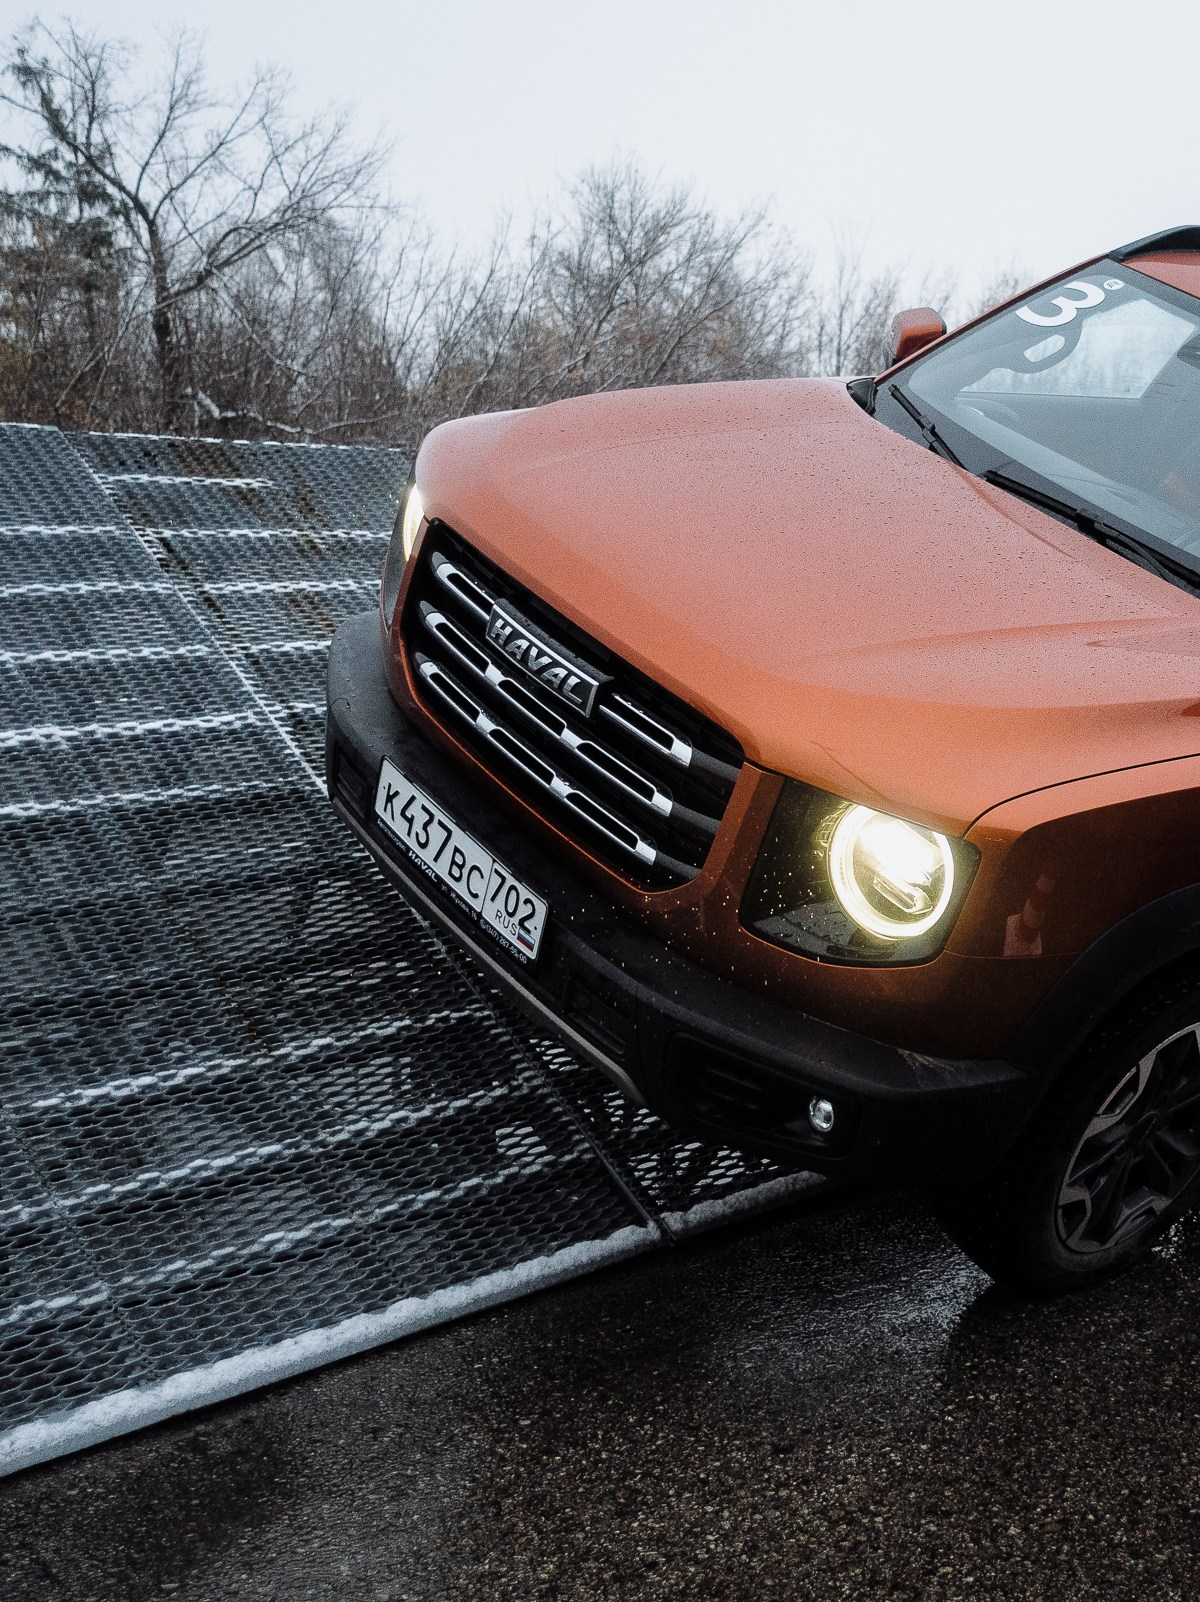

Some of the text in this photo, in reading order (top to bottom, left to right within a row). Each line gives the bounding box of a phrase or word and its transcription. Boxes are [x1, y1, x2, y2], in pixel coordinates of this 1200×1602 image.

[1014, 281, 1106, 327] 3
[490, 618, 583, 705] HAVAL
[408, 850, 438, 882] HAVAL
[495, 908, 518, 937] RUS
